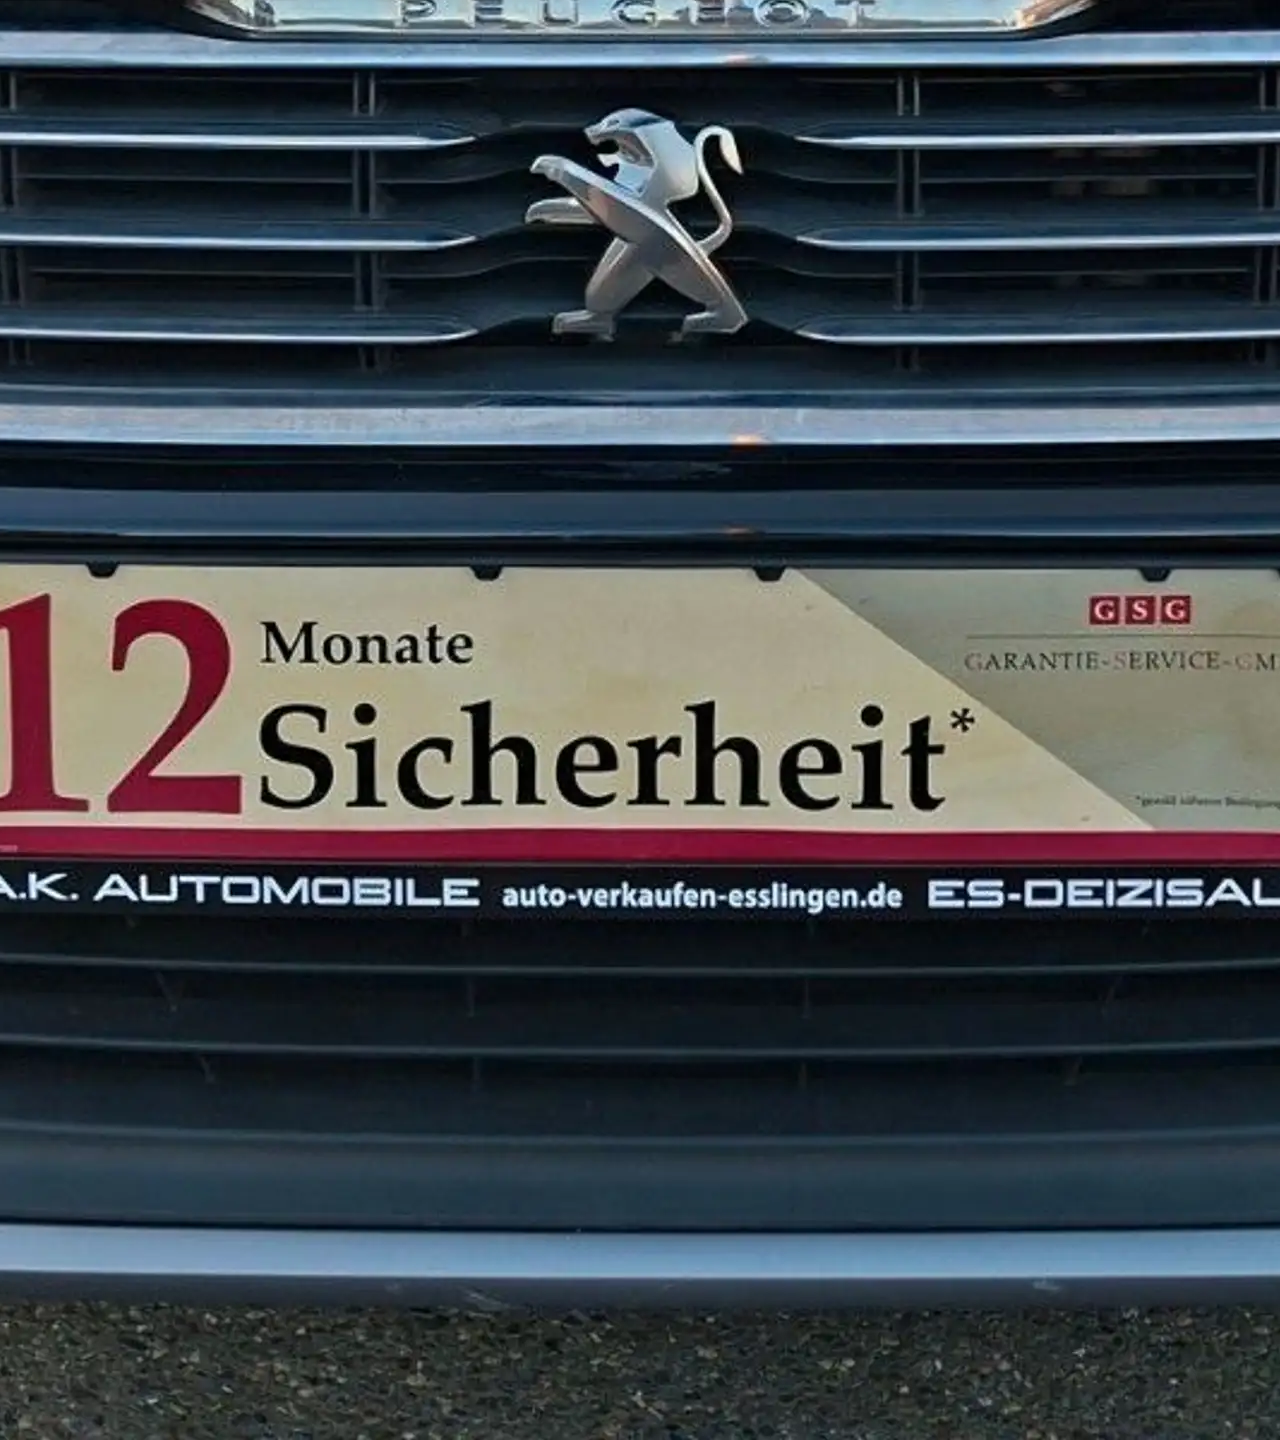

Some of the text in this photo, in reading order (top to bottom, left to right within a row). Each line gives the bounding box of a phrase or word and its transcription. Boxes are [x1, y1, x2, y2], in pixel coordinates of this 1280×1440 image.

[1092, 598, 1191, 623] GSG
[260, 621, 474, 667] Monate
[93, 873, 480, 907] AUTOMOBILE
[502, 880, 903, 914] auto-verkaufen-esslingen.de
